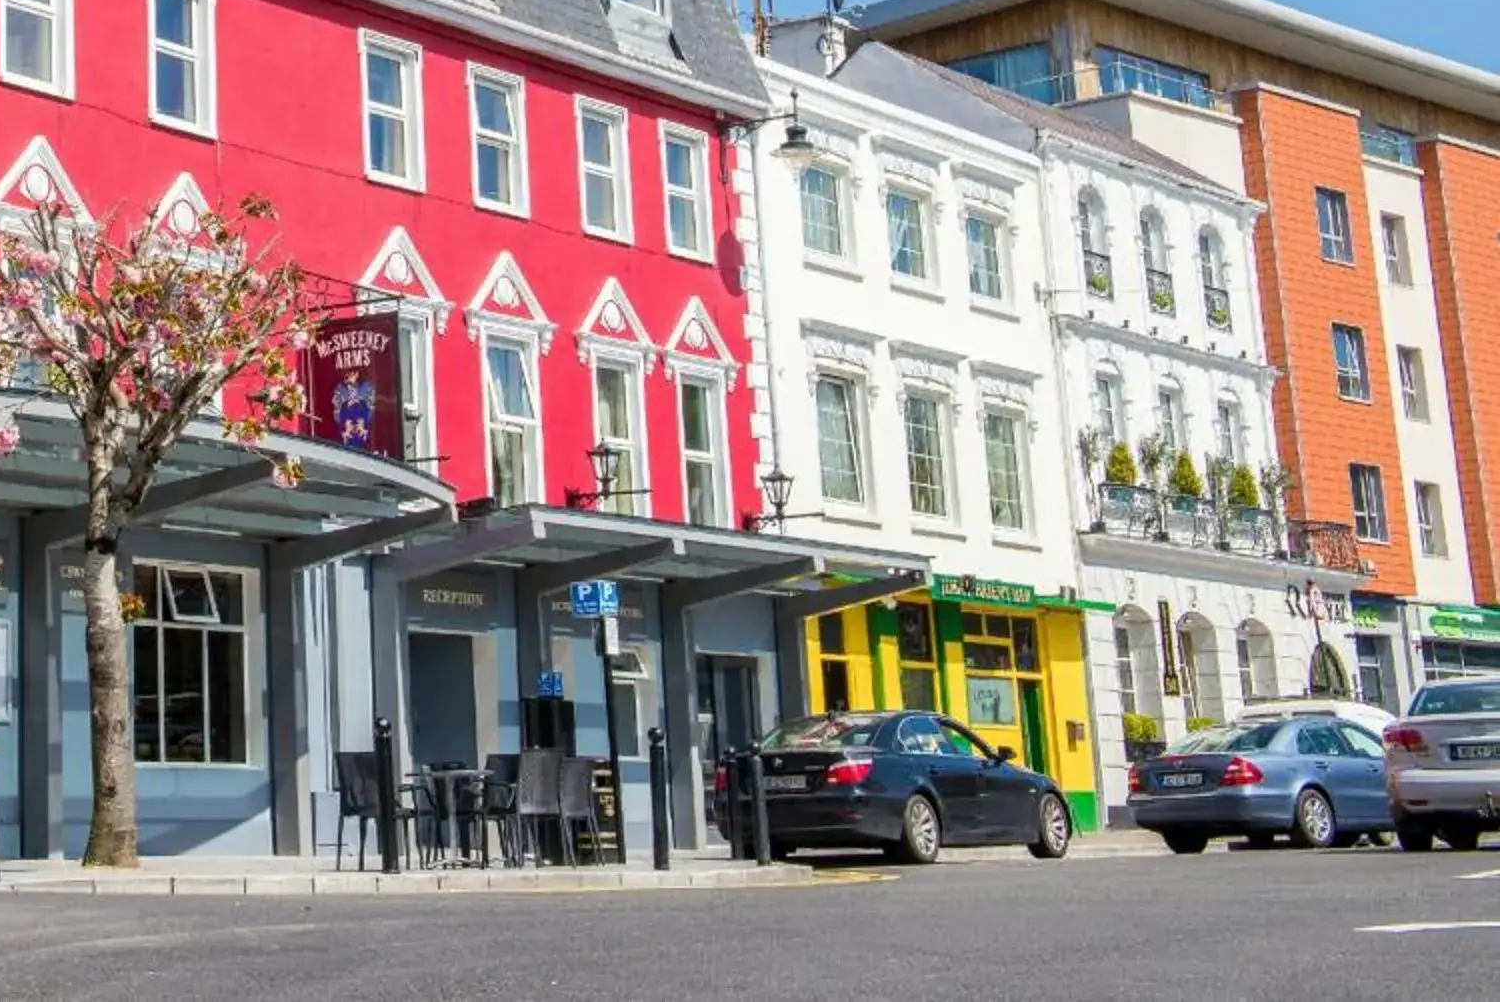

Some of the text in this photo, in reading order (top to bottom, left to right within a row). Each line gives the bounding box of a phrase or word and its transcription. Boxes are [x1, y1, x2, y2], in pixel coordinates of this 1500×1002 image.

[335, 348, 371, 370] ARMS
[422, 589, 484, 606] RECEPTION
[578, 585, 592, 600] P
[603, 584, 613, 599] P
